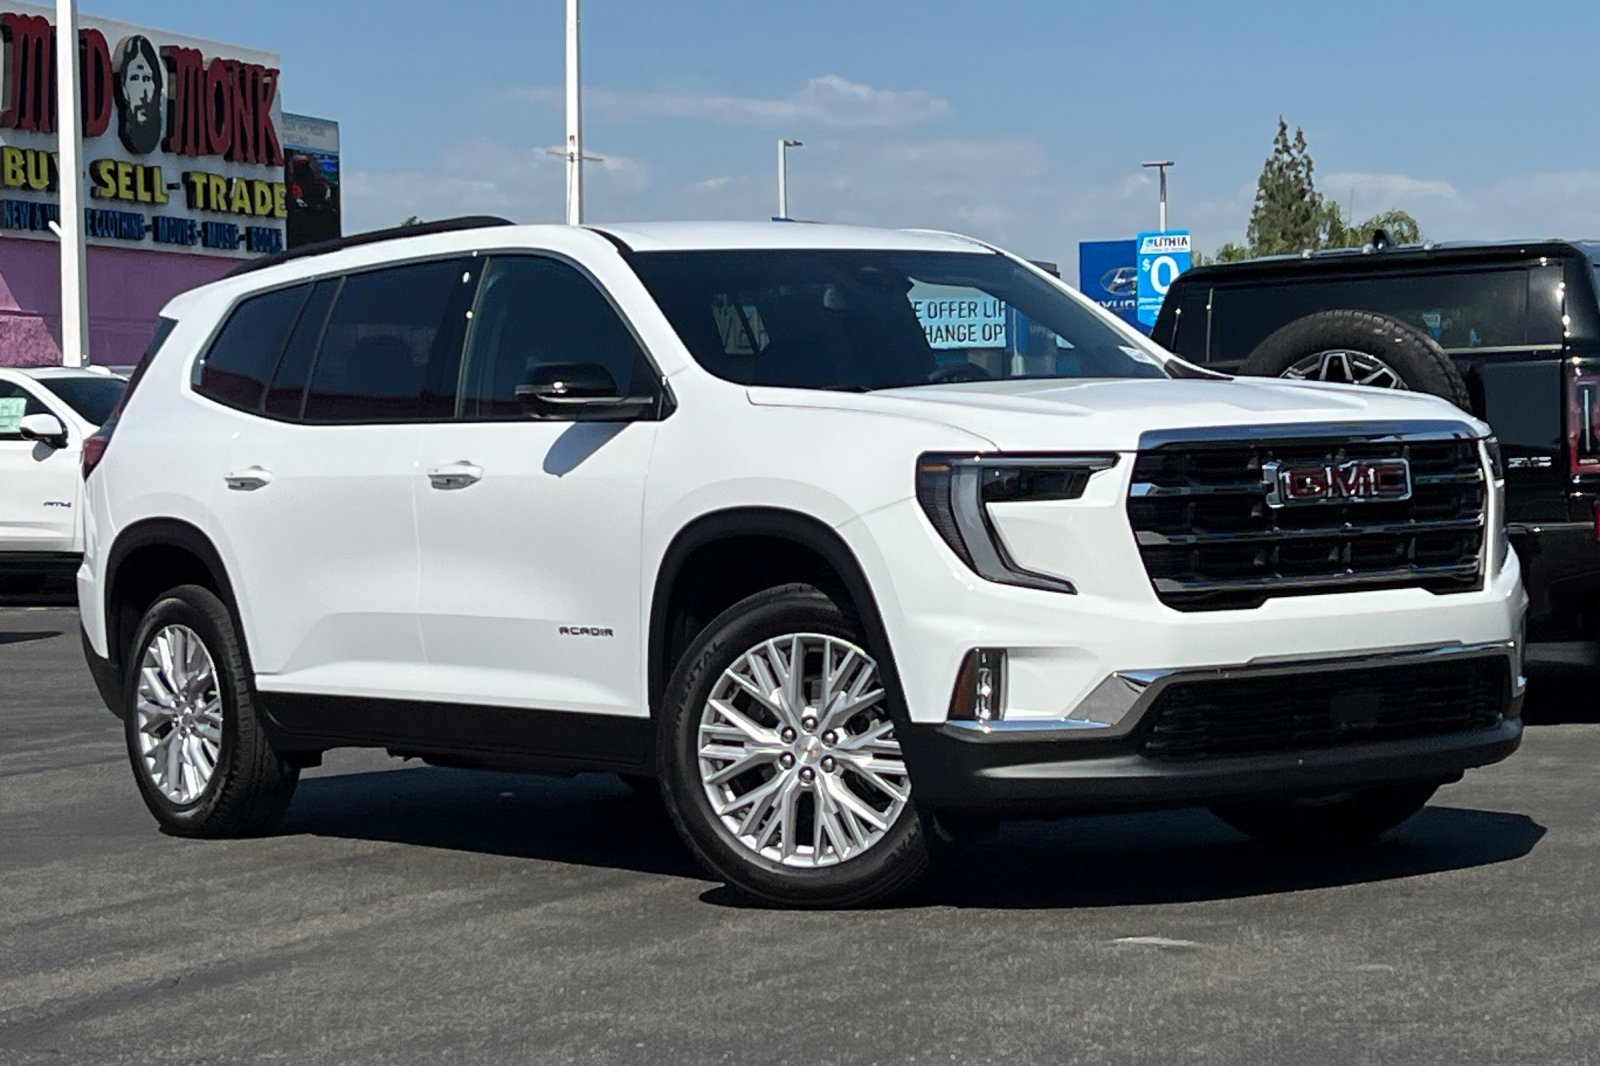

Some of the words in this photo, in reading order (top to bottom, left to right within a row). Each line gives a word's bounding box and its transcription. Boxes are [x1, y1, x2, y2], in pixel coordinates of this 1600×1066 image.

[0, 12, 113, 138] MD
[164, 45, 284, 166] MONK
[3, 146, 60, 190] BU
[94, 159, 169, 204] SELL
[187, 171, 288, 218] TRADE
[927, 301, 978, 319] OFFER
[1284, 462, 1406, 500] GMC
[558, 626, 614, 637] ACADIA
